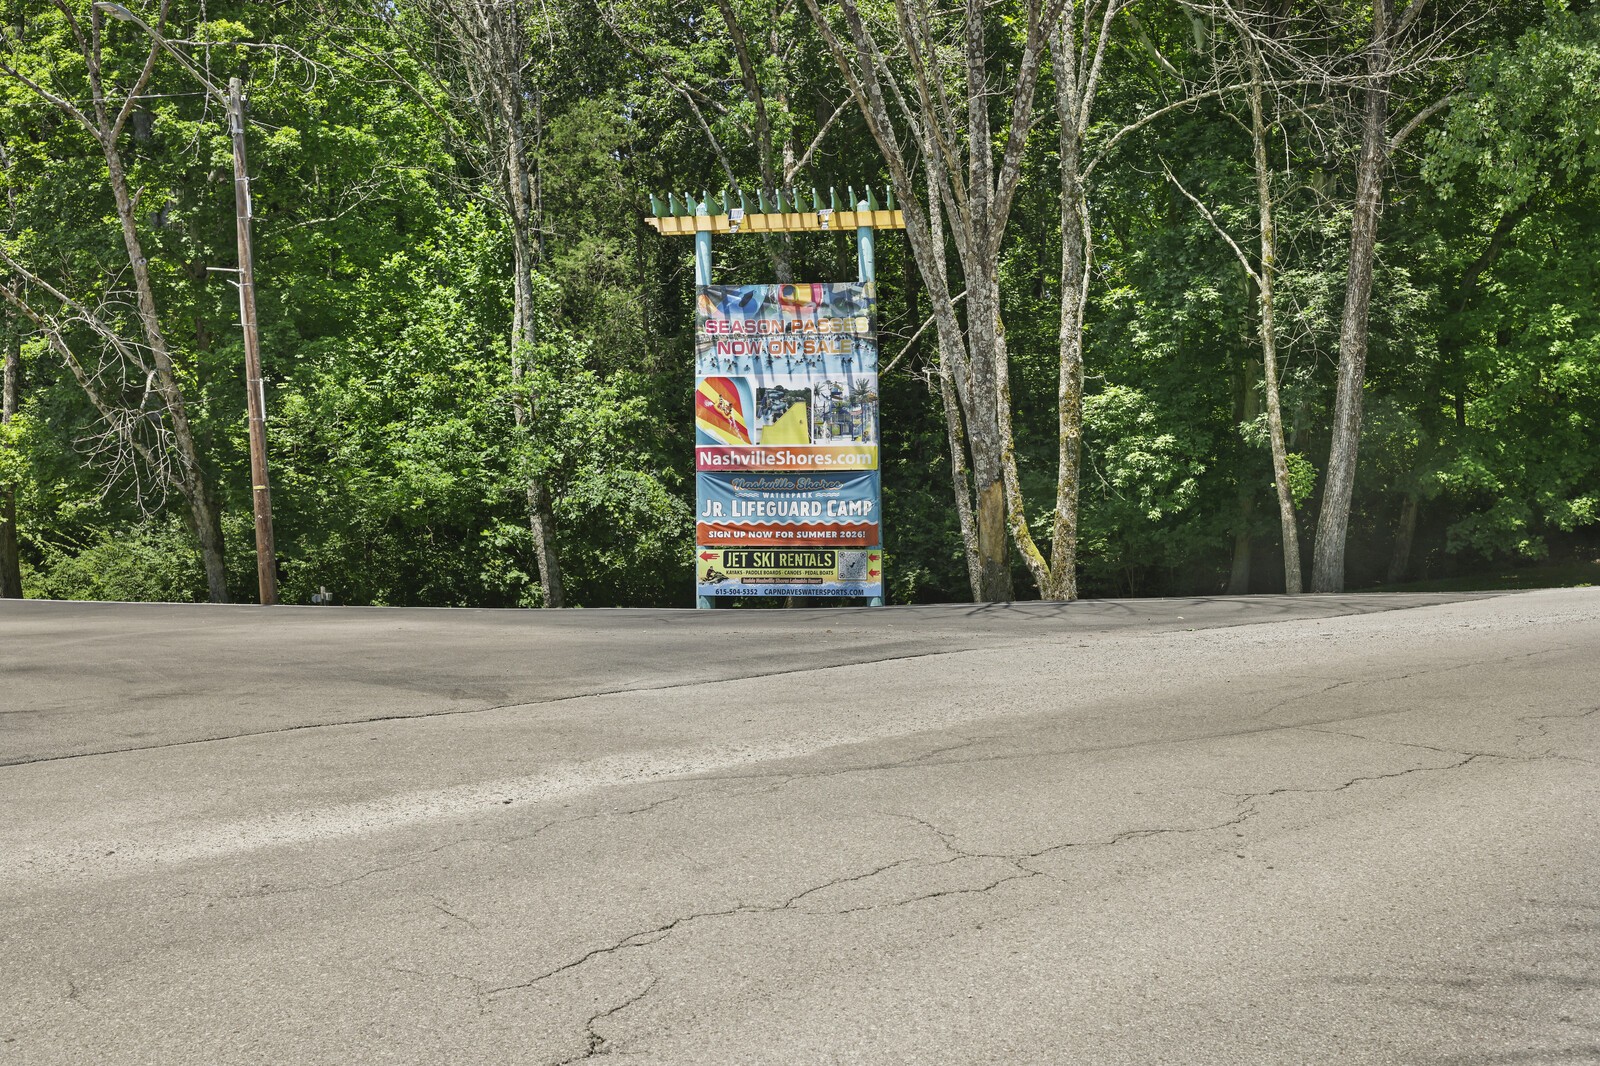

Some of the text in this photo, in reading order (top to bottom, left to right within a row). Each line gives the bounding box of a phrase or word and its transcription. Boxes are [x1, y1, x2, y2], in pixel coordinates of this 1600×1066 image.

[705, 317, 869, 334] SEASON PASSES
[717, 340, 853, 355] NOW ON SALE
[700, 451, 872, 466] NashvilleShores.com
[732, 478, 844, 491] Nashville Shores
[731, 499, 822, 517] LIFEGUARD
[827, 499, 874, 517] CAMP
[708, 531, 866, 539] SIGN UP NOW FOR SUMMER 2026!
[726, 551, 833, 567] JET SKI RENTALS
[764, 588, 864, 596] CAPNDAVESWATERSPORTS.COM
